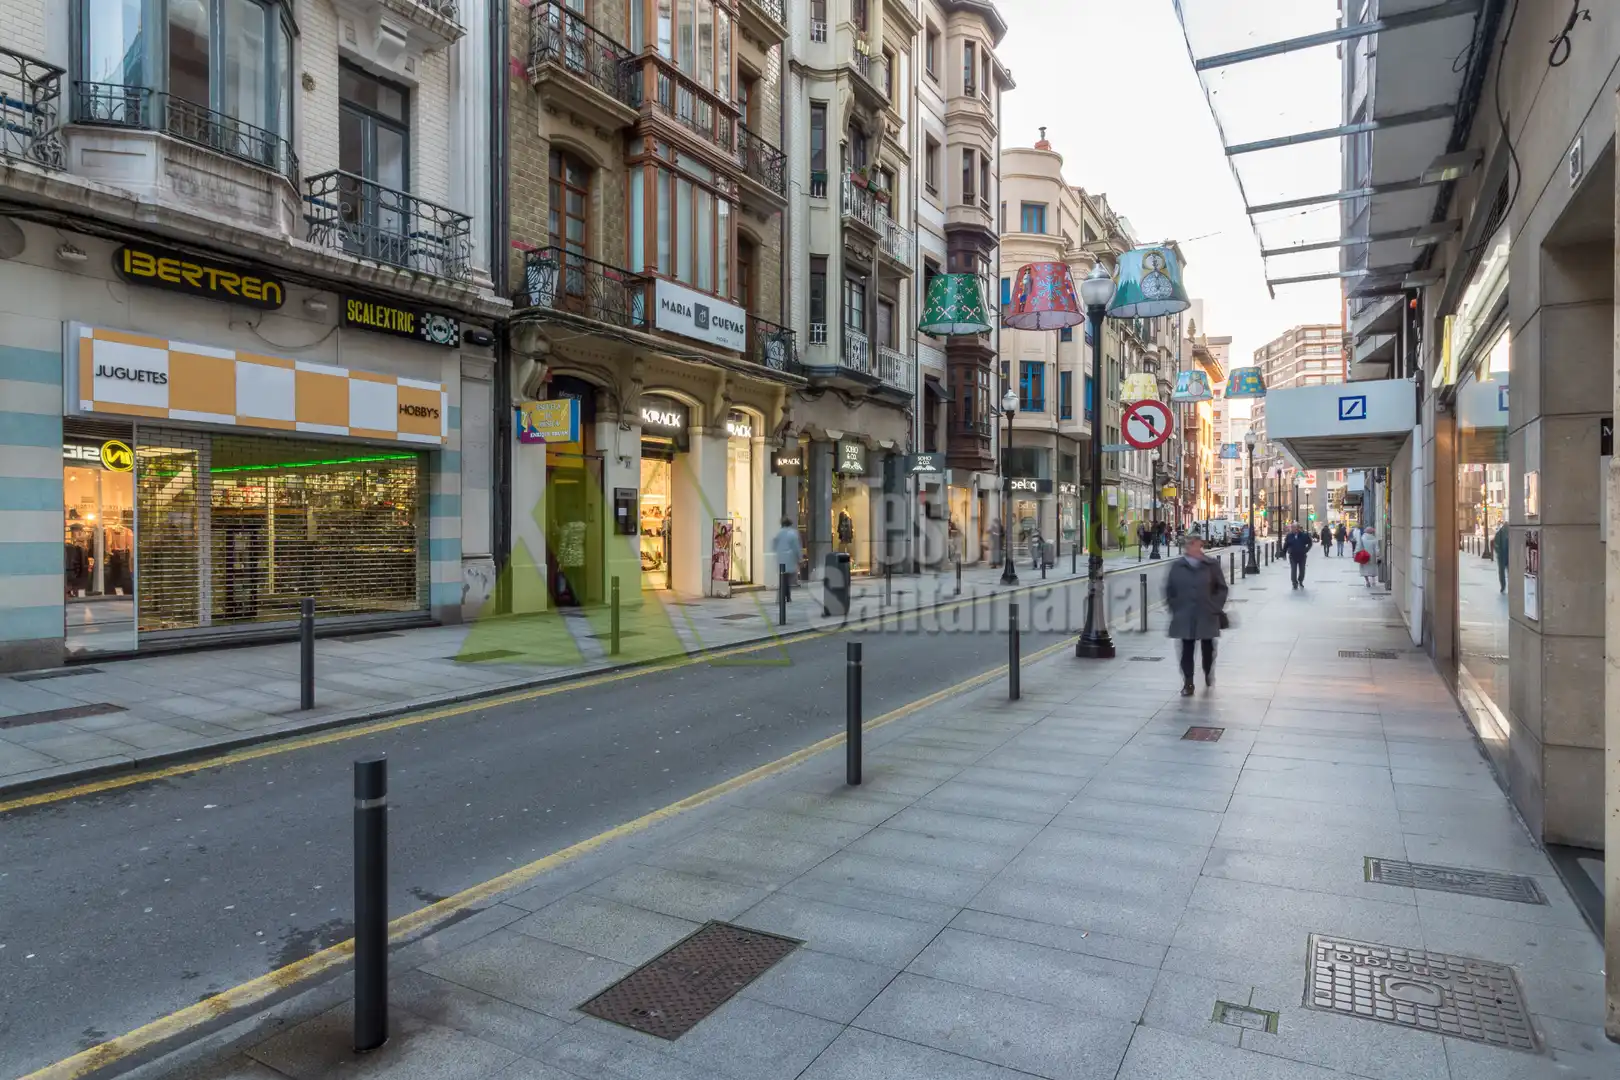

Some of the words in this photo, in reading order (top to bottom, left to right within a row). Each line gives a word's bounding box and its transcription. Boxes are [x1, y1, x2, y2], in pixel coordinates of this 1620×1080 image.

[347, 299, 414, 333] SCALEXTRIC
[661, 298, 692, 318] MARIA
[711, 315, 744, 334] CUEVAS
[96, 364, 168, 385] JUGUETES
[399, 403, 440, 419] HOBBY'S
[641, 408, 680, 428] KRACK
[727, 422, 752, 438] RACK
[845, 445, 858, 454] SOHO
[778, 457, 800, 466] KRACK
